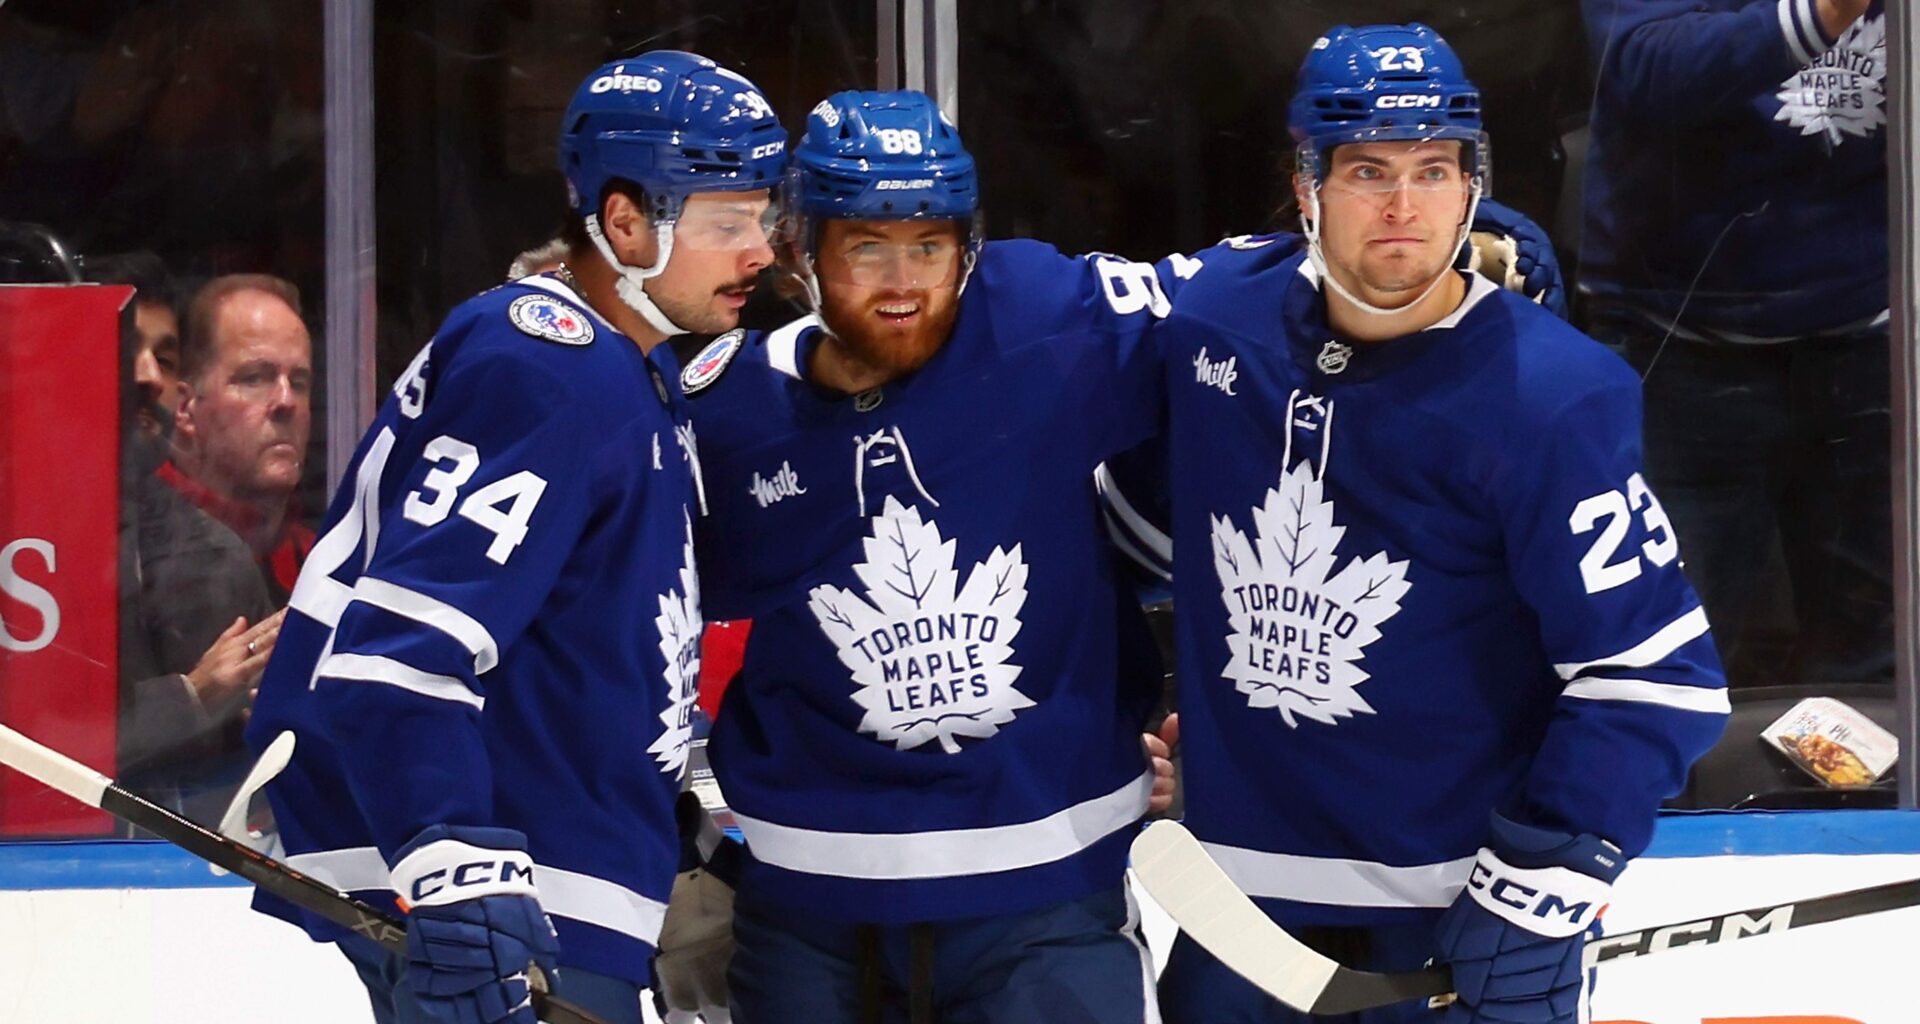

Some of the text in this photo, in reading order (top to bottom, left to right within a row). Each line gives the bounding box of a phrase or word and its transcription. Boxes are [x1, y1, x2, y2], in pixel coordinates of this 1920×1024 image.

[1377, 46, 1424, 72] 23
[1801, 50, 1874, 77] RONTO
[590, 74, 662, 94] OREO
[1376, 95, 1441, 108] CCM
[1800, 74, 1861, 91] MAPLE
[1802, 93, 1863, 109] LEAFS
[812, 100, 839, 128] OREO
[752, 141, 785, 160] CCM
[881, 128, 923, 156] 88
[875, 180, 934, 190] BAUER
[1193, 346, 1237, 396] Milk
[403, 435, 548, 565] 34
[749, 460, 807, 508] Milk
[1569, 472, 1679, 594] 23
[0, 538, 60, 652] S
[1233, 583, 1359, 639] TORONTO
[852, 613, 999, 663] TORONTO
[1250, 615, 1332, 656] MAPLE
[881, 644, 983, 683] MAPLE
[1249, 643, 1331, 684] LEAFS
[887, 674, 989, 712] LEAFS
[412, 861, 534, 900] CCM
[1468, 860, 1592, 924] CCM
[1581, 904, 1795, 969] CCM
